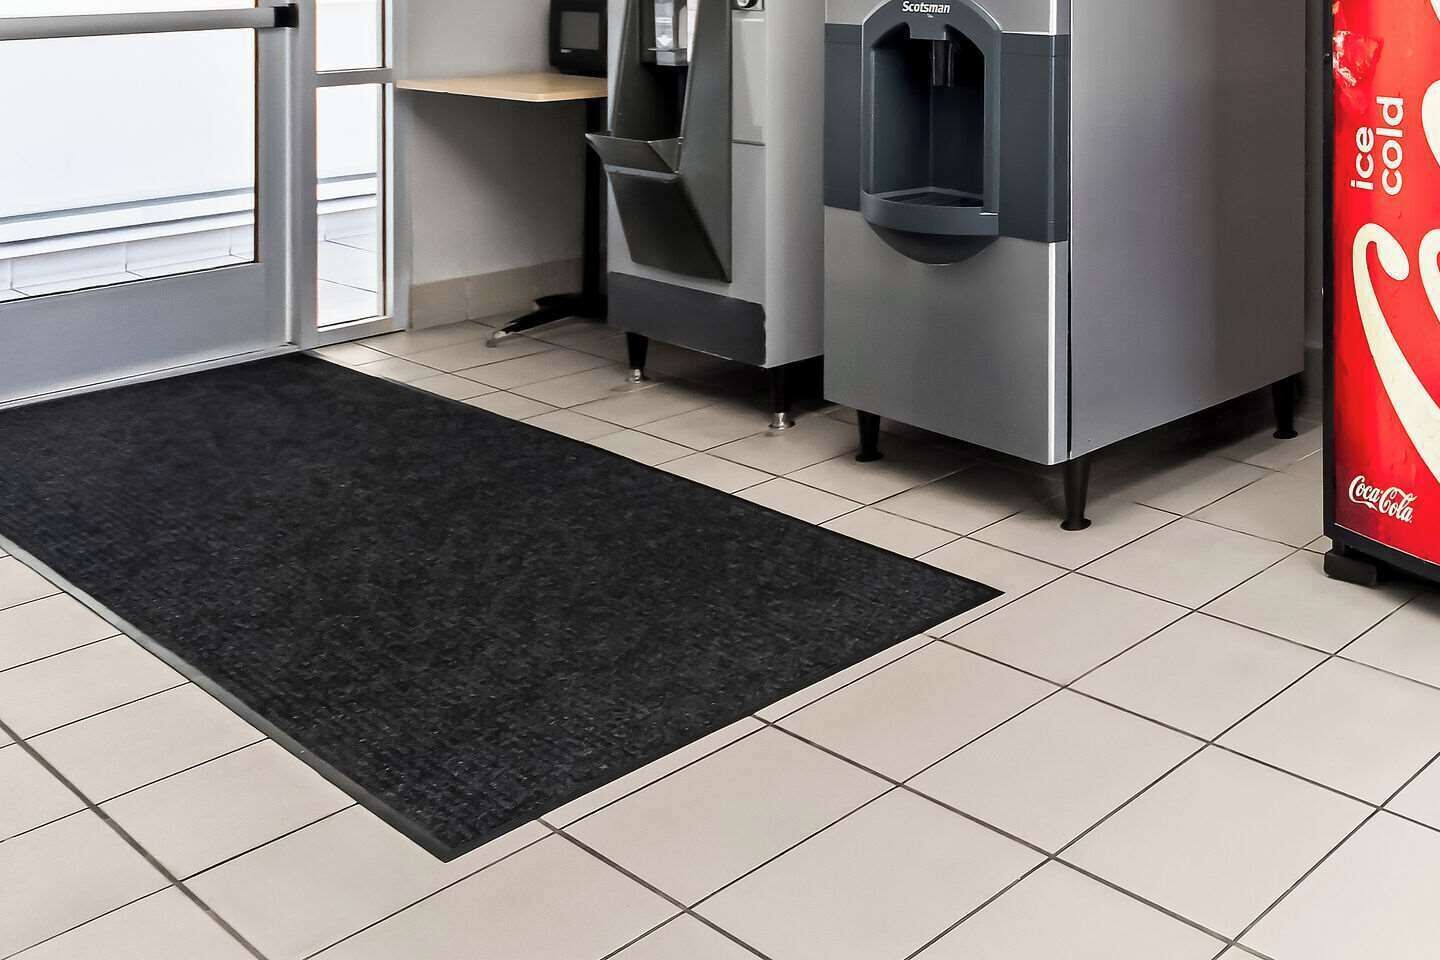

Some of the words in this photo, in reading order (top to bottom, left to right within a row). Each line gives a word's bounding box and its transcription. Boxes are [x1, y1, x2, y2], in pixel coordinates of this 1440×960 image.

[902, 0, 951, 14] Scotsman
[1350, 127, 1374, 190] ice
[1376, 96, 1404, 196] cold
[1348, 475, 1418, 523] Coca-Cola
